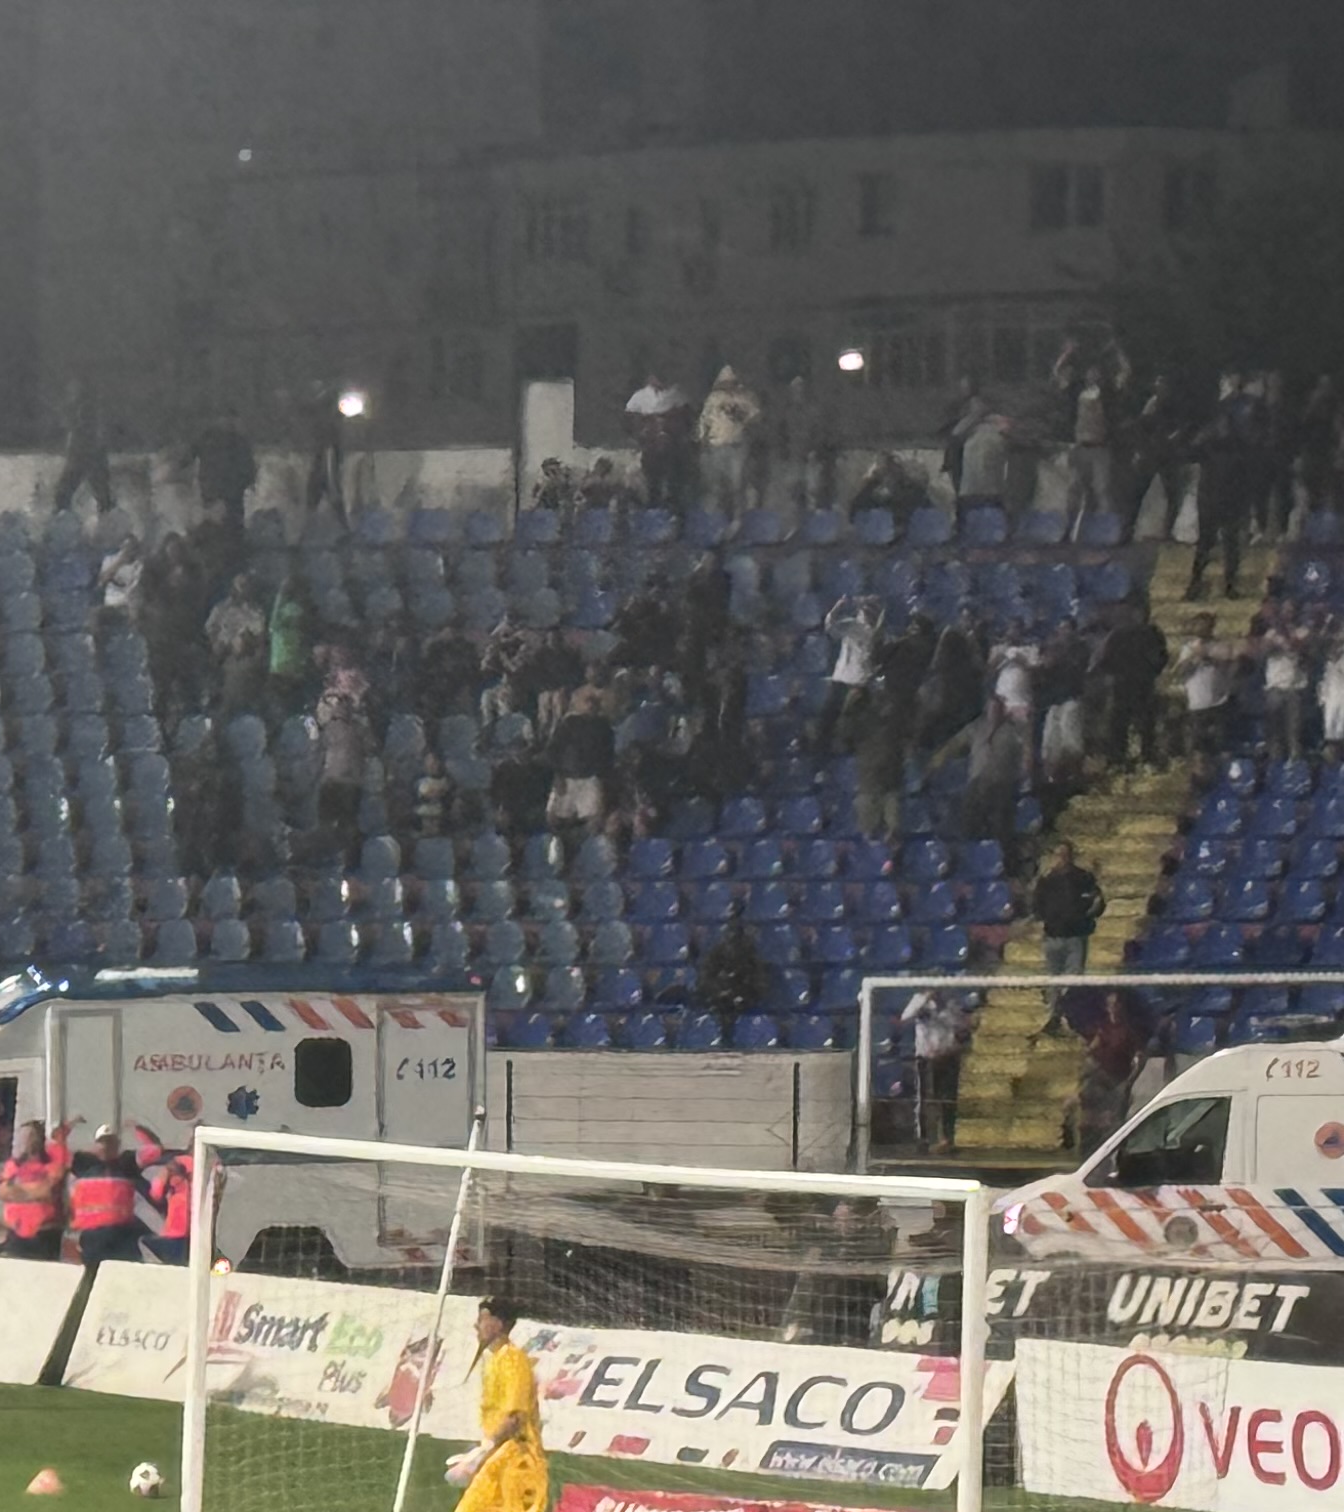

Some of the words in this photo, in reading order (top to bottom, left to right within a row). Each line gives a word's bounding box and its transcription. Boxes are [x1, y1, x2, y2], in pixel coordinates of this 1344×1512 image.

[1281, 1060, 1322, 1079] 112
[233, 1302, 330, 1353] Smart
[1107, 1273, 1311, 1334] UNIBET
[317, 1360, 367, 1393] Plus
[577, 1355, 906, 1436] ELSACO
